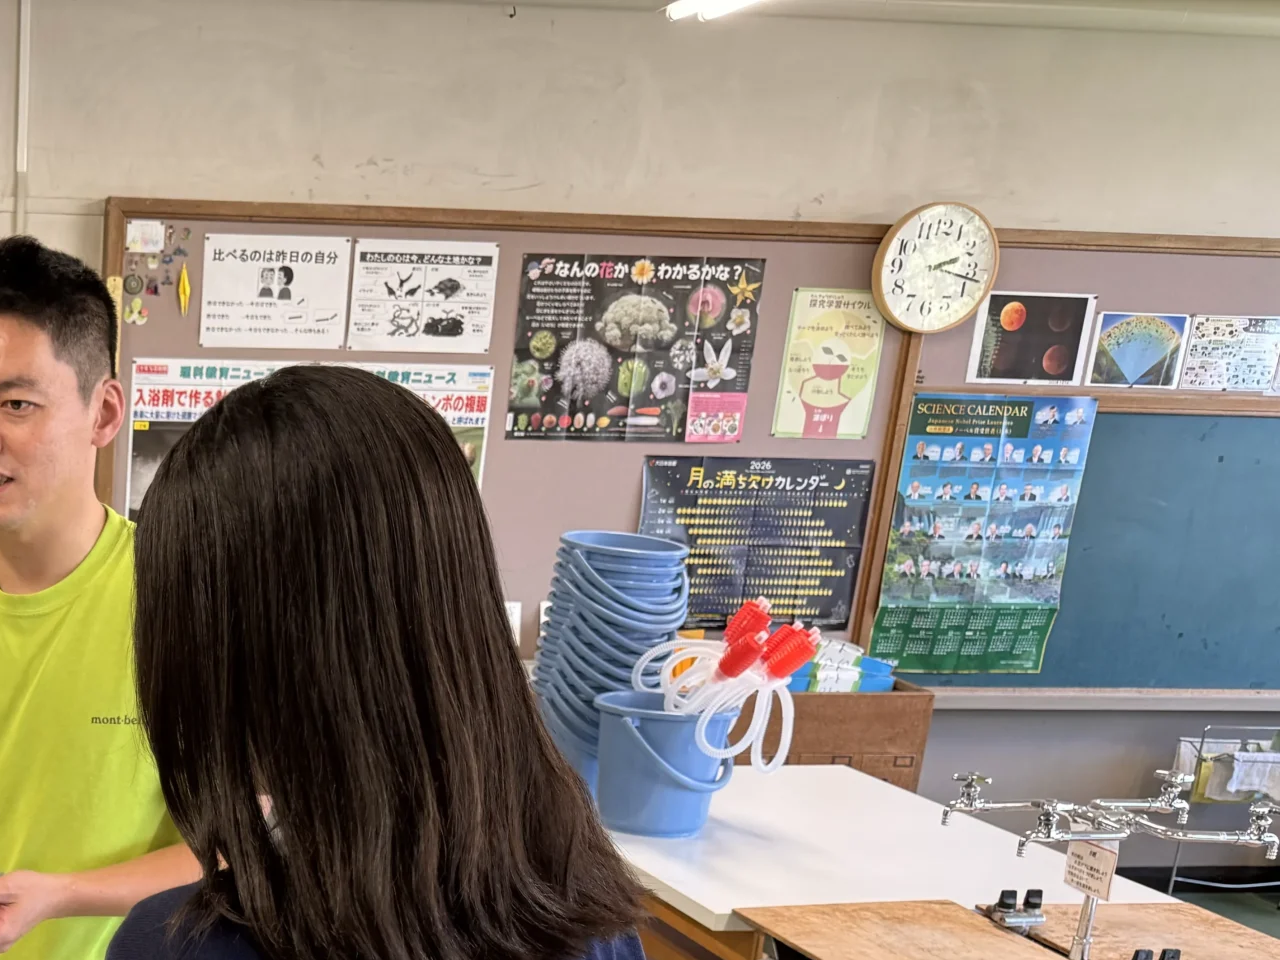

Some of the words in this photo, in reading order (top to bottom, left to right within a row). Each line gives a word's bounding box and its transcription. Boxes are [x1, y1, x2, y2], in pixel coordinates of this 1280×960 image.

[918, 222, 932, 240] 11
[935, 219, 954, 236] 12
[899, 239, 917, 256] 10
[966, 241, 976, 256] 2
[212, 248, 338, 265] 比べるのは昨日の自分
[555, 261, 629, 279] なんの花か
[657, 262, 743, 280] わかるかな？
[891, 258, 903, 274] 9
[965, 262, 978, 279] 3
[892, 279, 904, 295] 8
[809, 299, 872, 310] 探究学習サイクル
[906, 294, 917, 312] 7
[920, 301, 931, 316] 6
[423, 394, 487, 413] ンボの複眼
[917, 403, 965, 415] SCIENCE
[967, 404, 1028, 417] CALENDAR
[750, 461, 772, 470] 2026
[687, 467, 829, 490] 月の満ち欠けカレンダー
